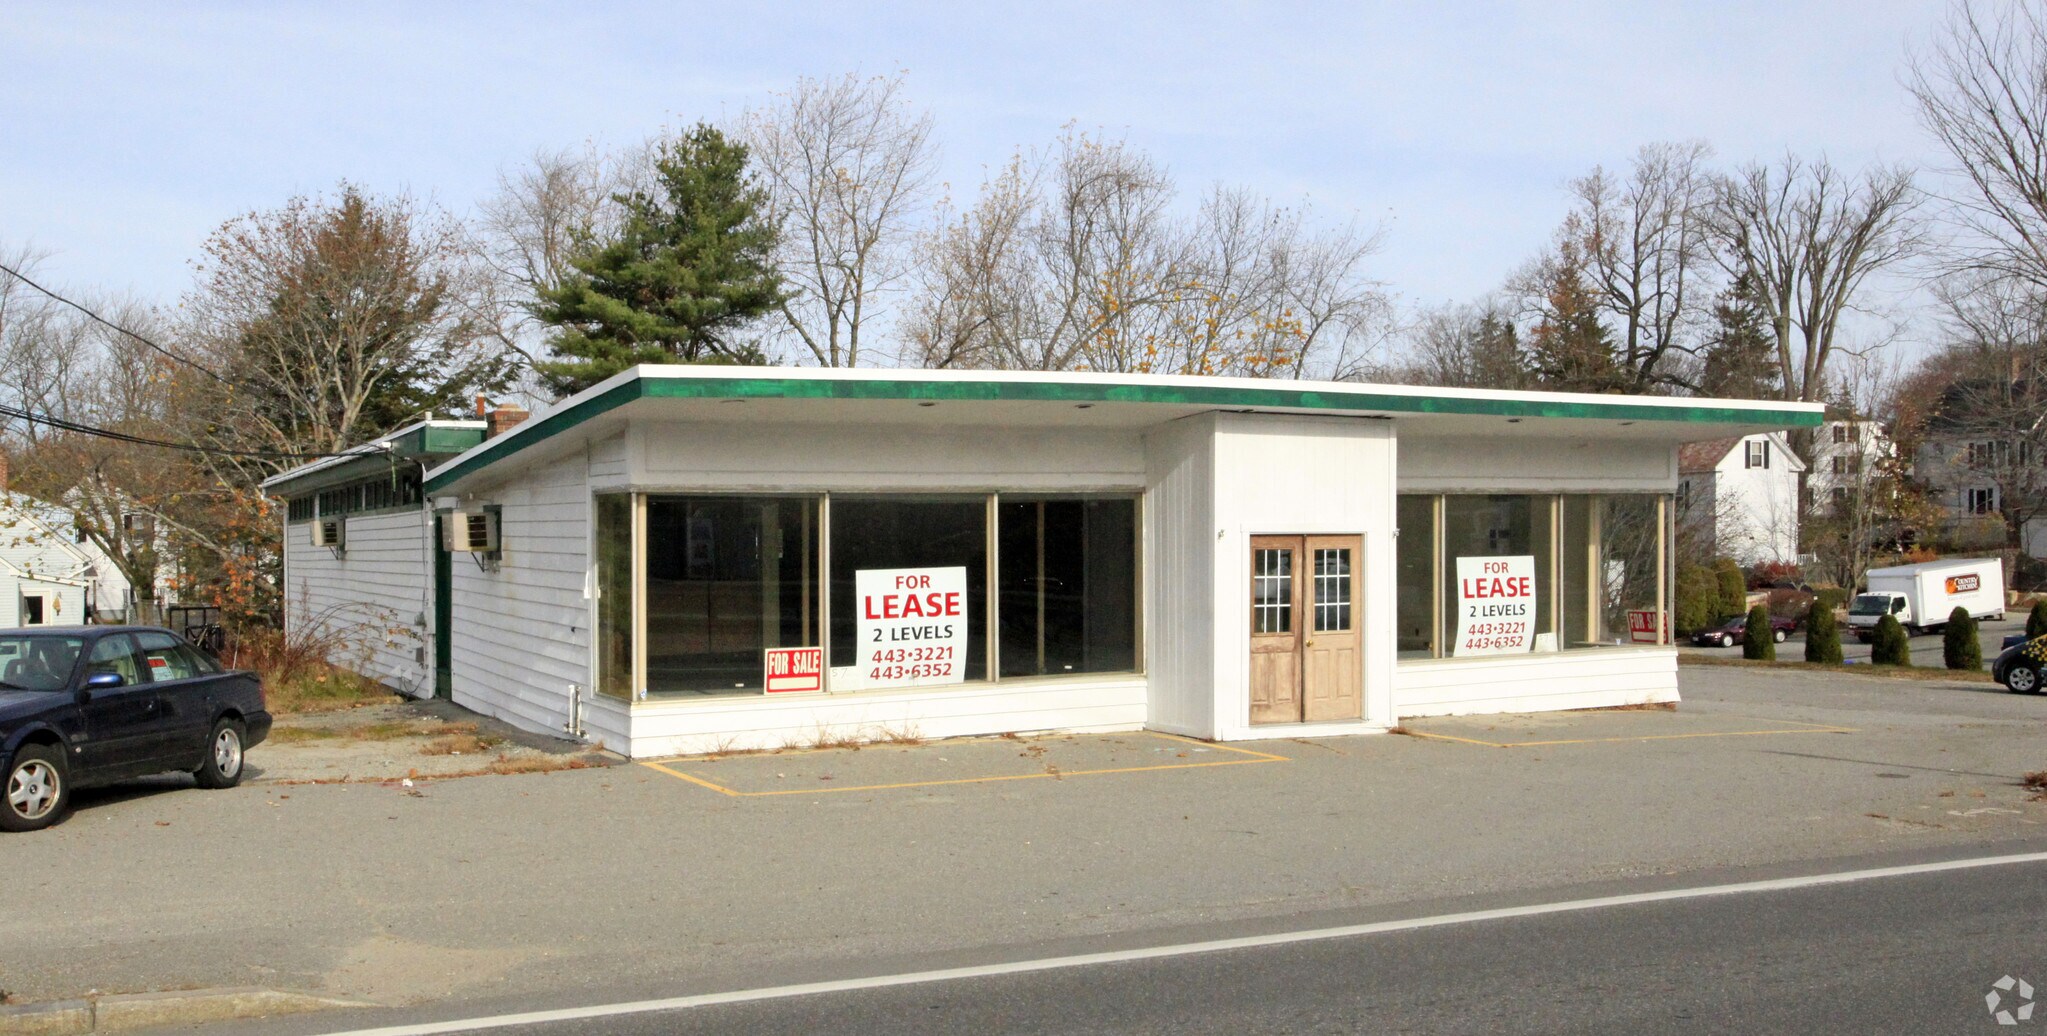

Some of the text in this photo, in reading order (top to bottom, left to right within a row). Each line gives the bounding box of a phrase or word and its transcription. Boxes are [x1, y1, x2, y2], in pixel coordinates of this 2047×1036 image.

[1484, 562, 1509, 574] FOR
[896, 575, 930, 590] FOR
[1463, 577, 1531, 599] LEASE
[865, 592, 960, 620] LEASE
[1470, 604, 1526, 617] 2 LEVELS
[1629, 613, 1645, 629] FOR
[873, 624, 953, 642] 2 LEVELS
[768, 651, 820, 675] FOR SALE
